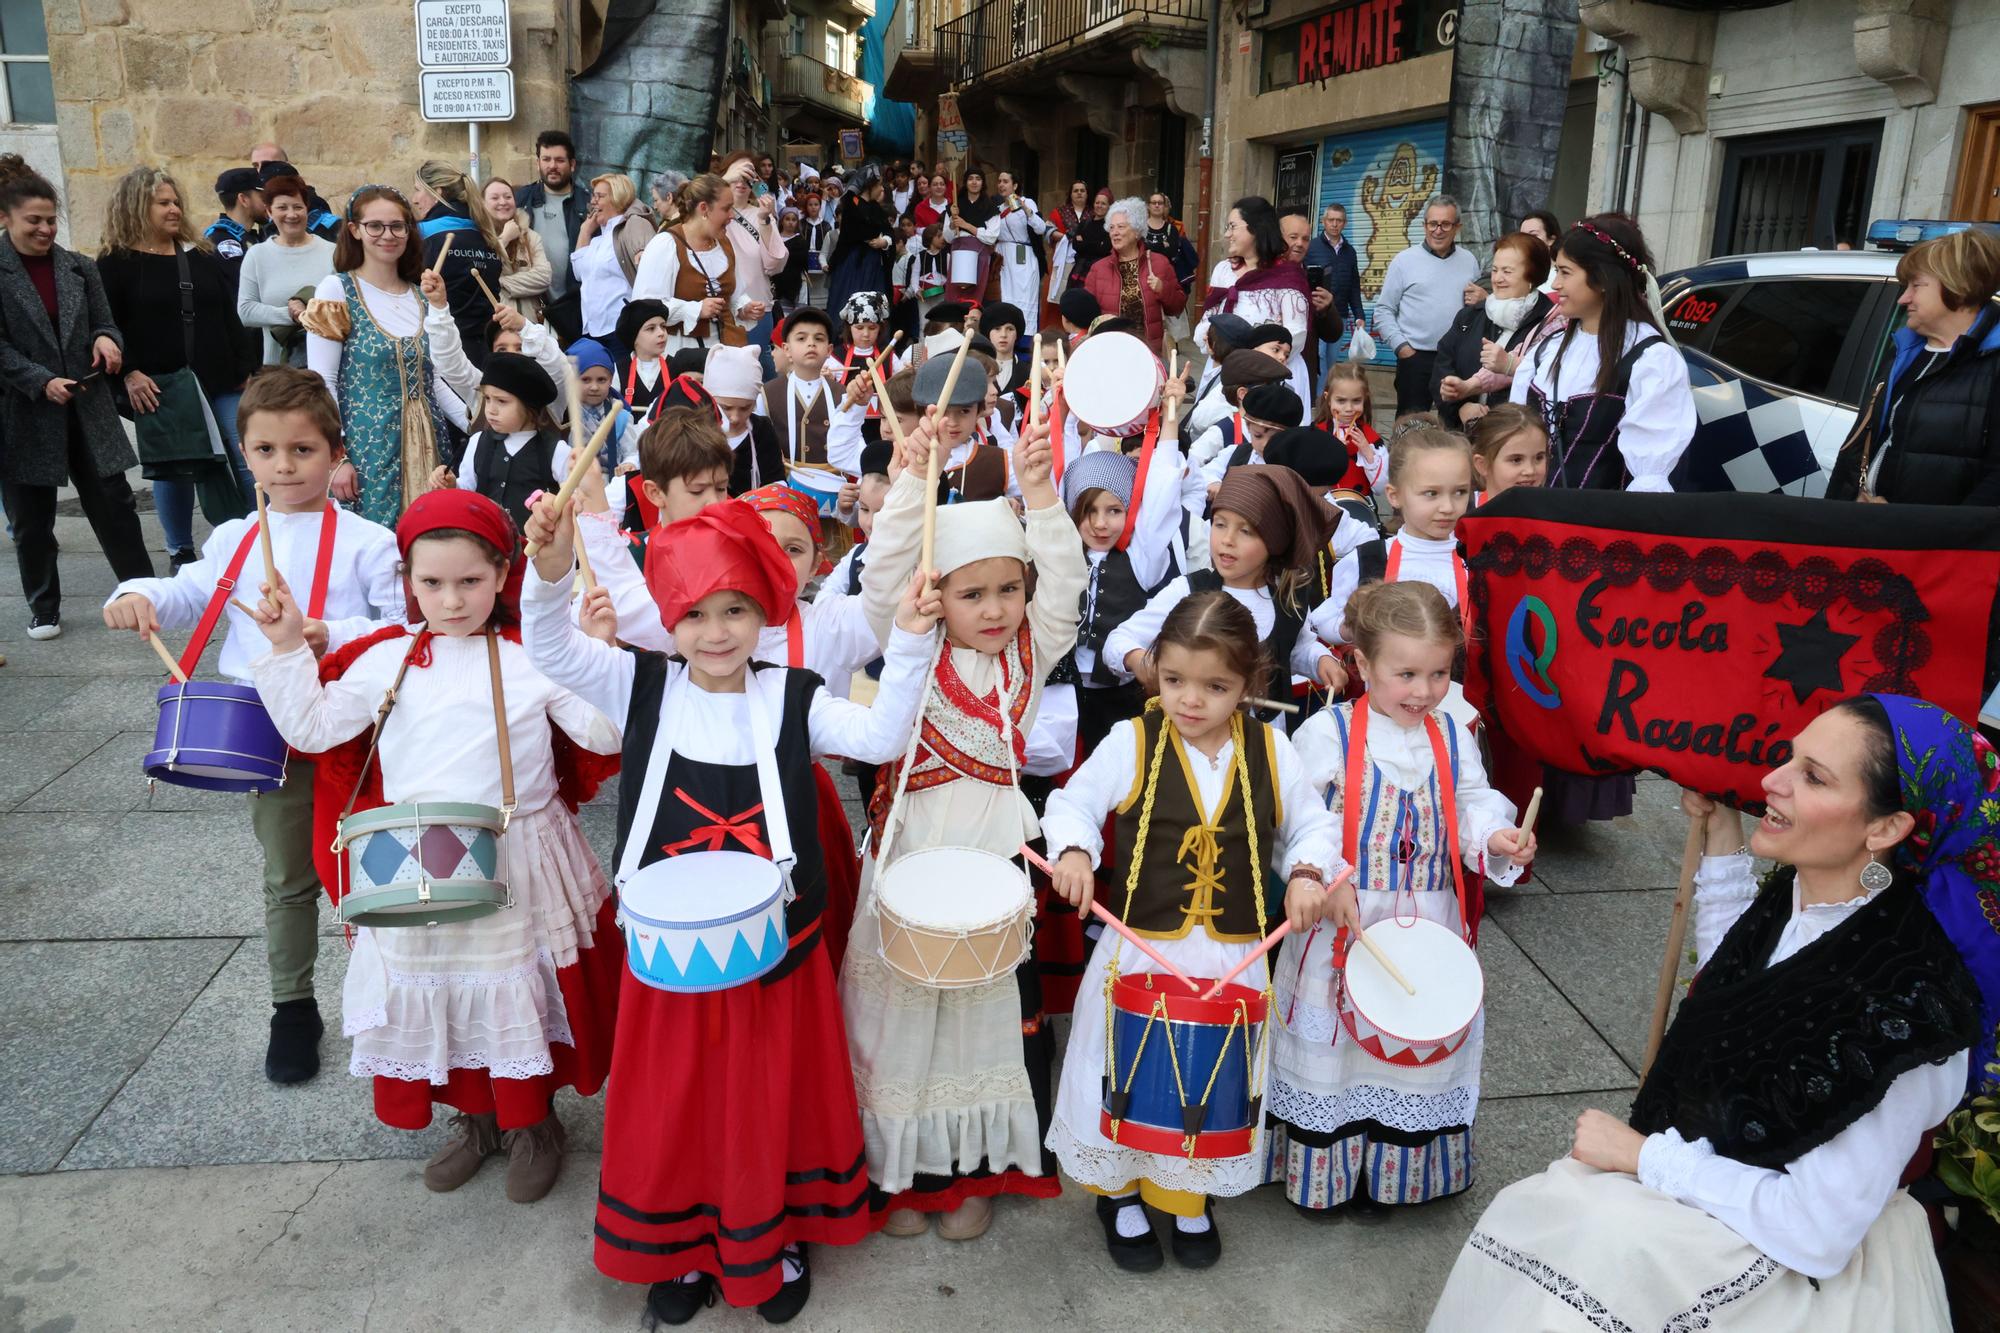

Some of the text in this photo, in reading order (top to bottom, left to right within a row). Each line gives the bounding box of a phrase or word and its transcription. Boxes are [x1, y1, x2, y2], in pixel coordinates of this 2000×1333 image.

[445, 4, 481, 14] EXCEPTO
[426, 17, 454, 27] CARGA
[460, 16, 504, 26] DESCARGA
[427, 28, 504, 39] DE 08:00 A 11:00 H.
[482, 40, 505, 49] TAXIS
[1298, 0, 1403, 84] REMATE
[435, 52, 499, 62] E AUTORIZADOS
[437, 79, 470, 88] EXCEPTO
[434, 90, 501, 100] ACCESO REXISTRO
[433, 102, 503, 113] DE 09:00 A 17:00 H.
[1684, 300, 1717, 322] 092
[1576, 578, 1729, 653] Escola
